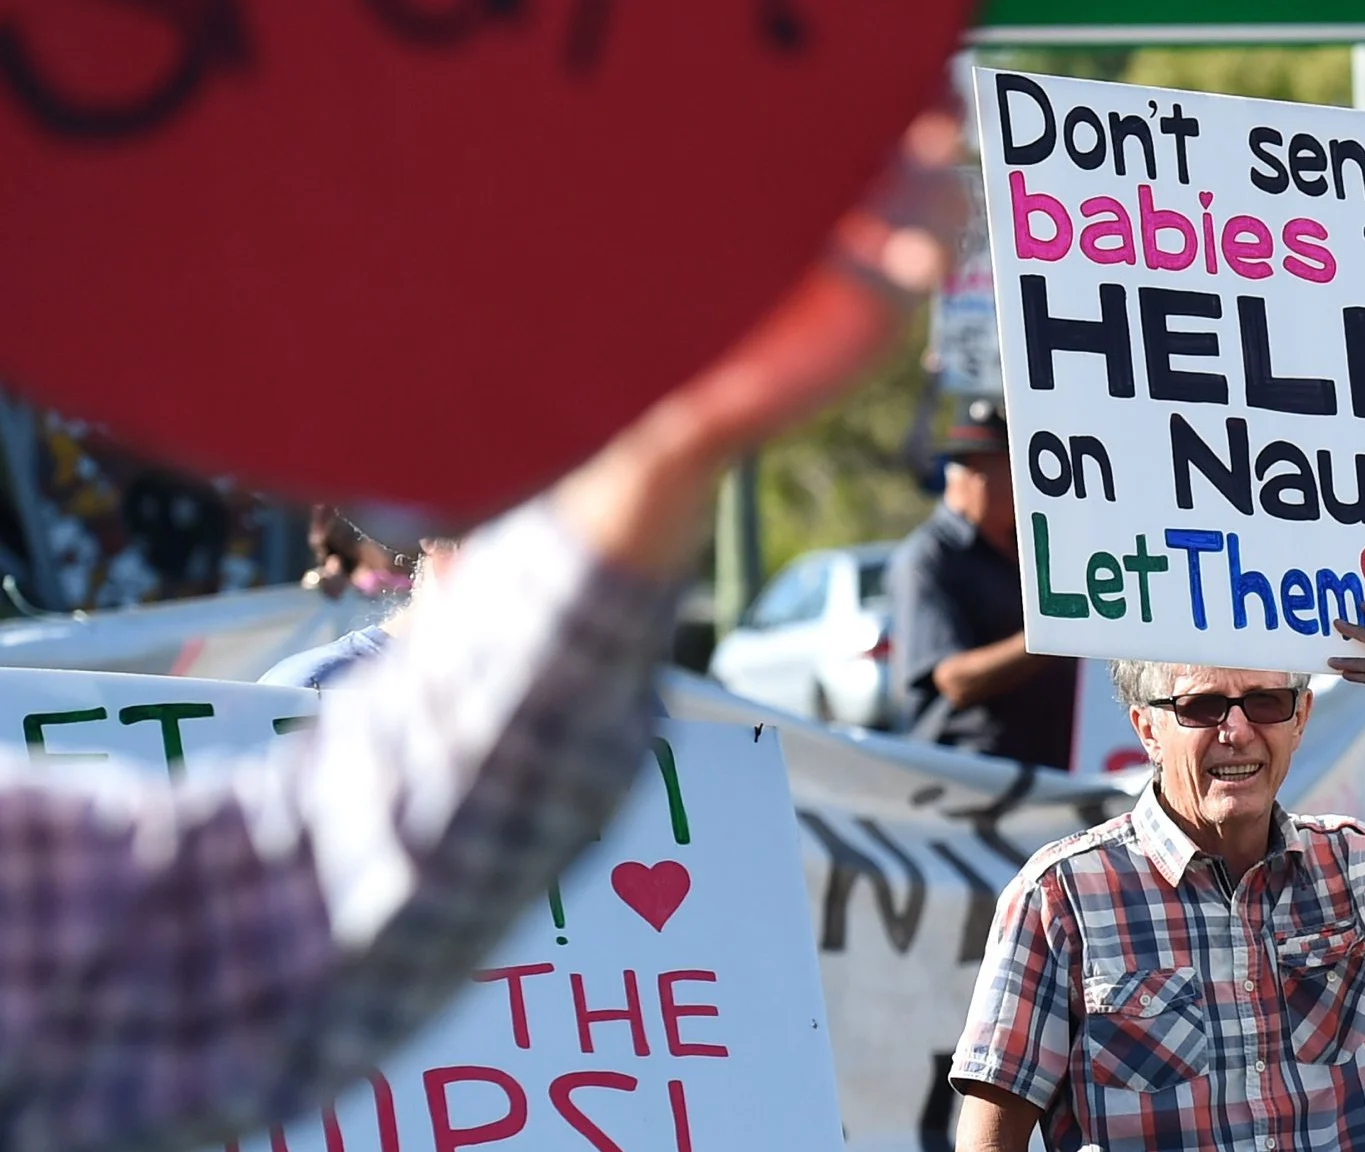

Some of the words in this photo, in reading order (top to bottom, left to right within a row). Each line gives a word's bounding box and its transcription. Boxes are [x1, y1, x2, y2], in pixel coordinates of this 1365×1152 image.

[995, 72, 1200, 184] Don't
[1008, 170, 1338, 284] babies
[1028, 430, 1117, 502] on
[472, 962, 729, 1058] THE
